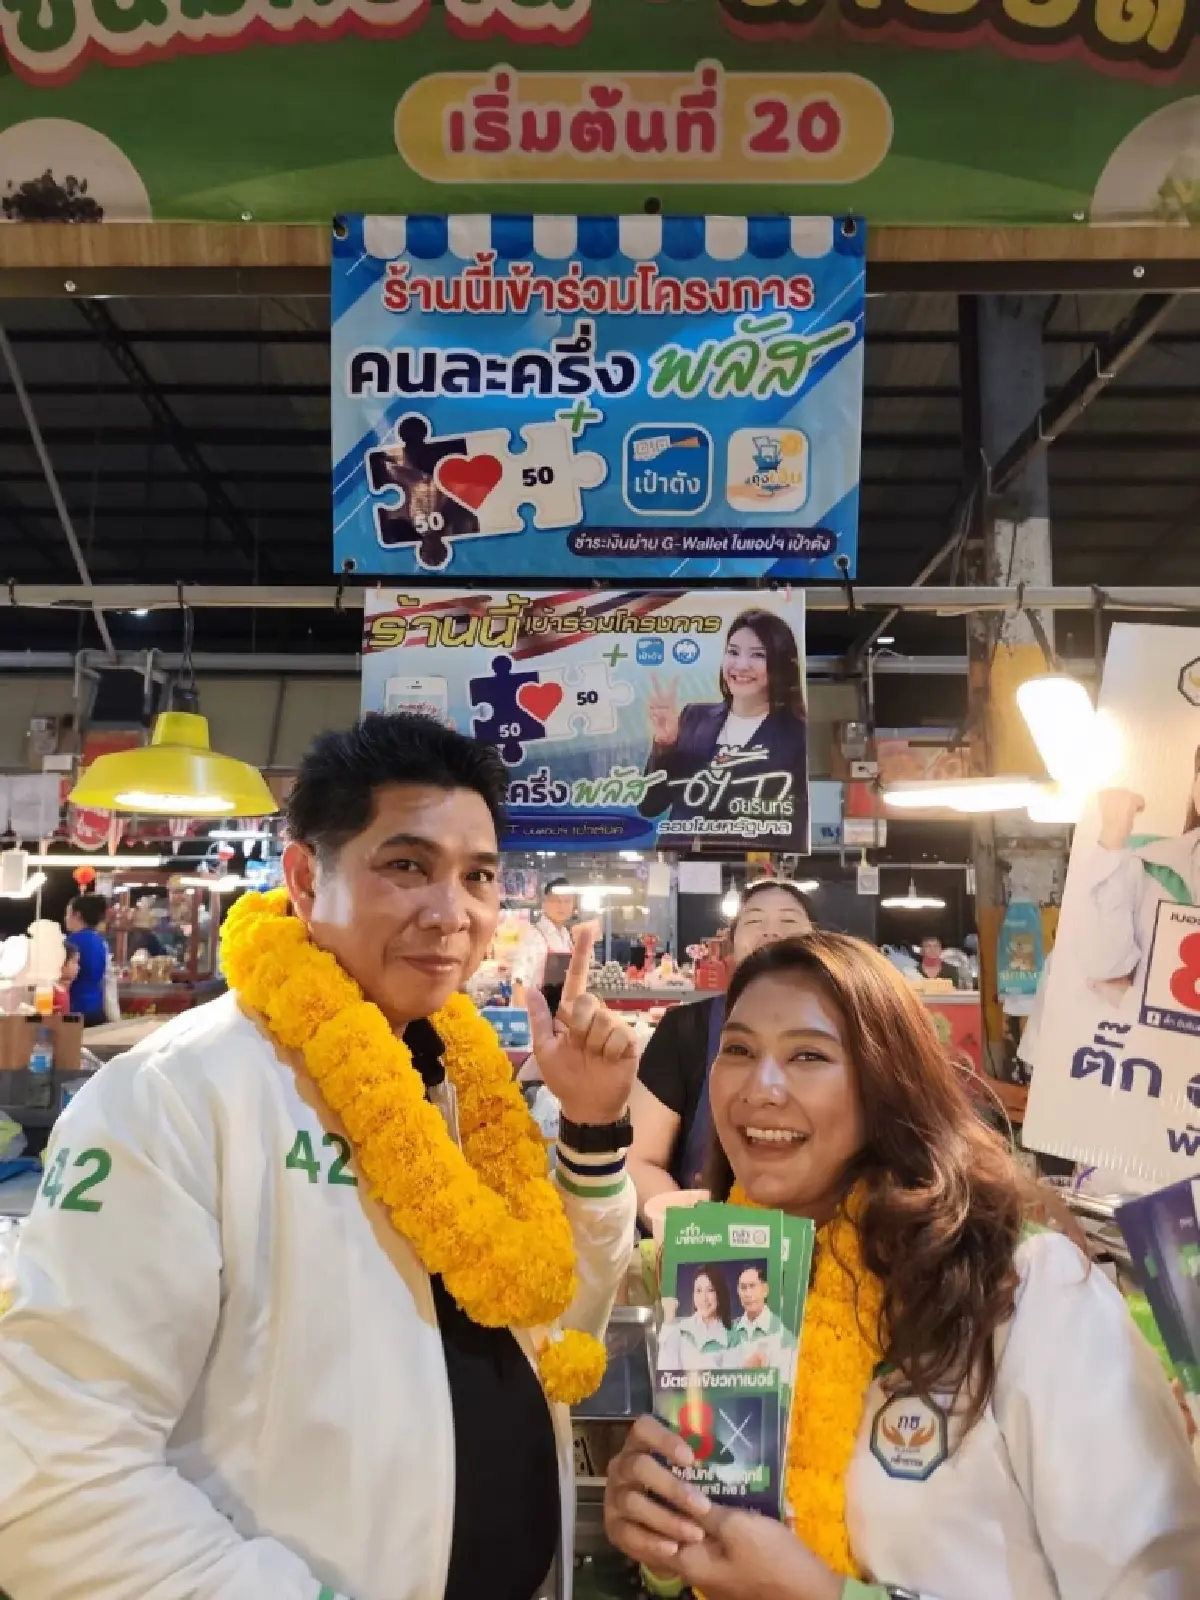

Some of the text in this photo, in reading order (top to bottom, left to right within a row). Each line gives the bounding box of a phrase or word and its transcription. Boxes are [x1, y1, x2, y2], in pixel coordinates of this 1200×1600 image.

[449, 67, 841, 153] เริ่มต้นที่ 20
[384, 252, 813, 312] ร้านนี้เข้าร่วมโครงการ
[350, 318, 850, 395] คนละครึ่ง พลัส
[521, 466, 555, 487] 50
[635, 469, 701, 494] เป๋าตัง
[413, 514, 444, 533] 50
[573, 534, 659, 551] ชำระเงินผ่าน
[661, 535, 728, 551] G-Wallet
[788, 533, 831, 551] เป๋าตัง
[369, 593, 723, 648] ร้านนี้ เข้าร่วมโครงการ
[576, 690, 599, 705] 50
[500, 723, 521, 737] 50
[284, 1129, 359, 1187] 42
